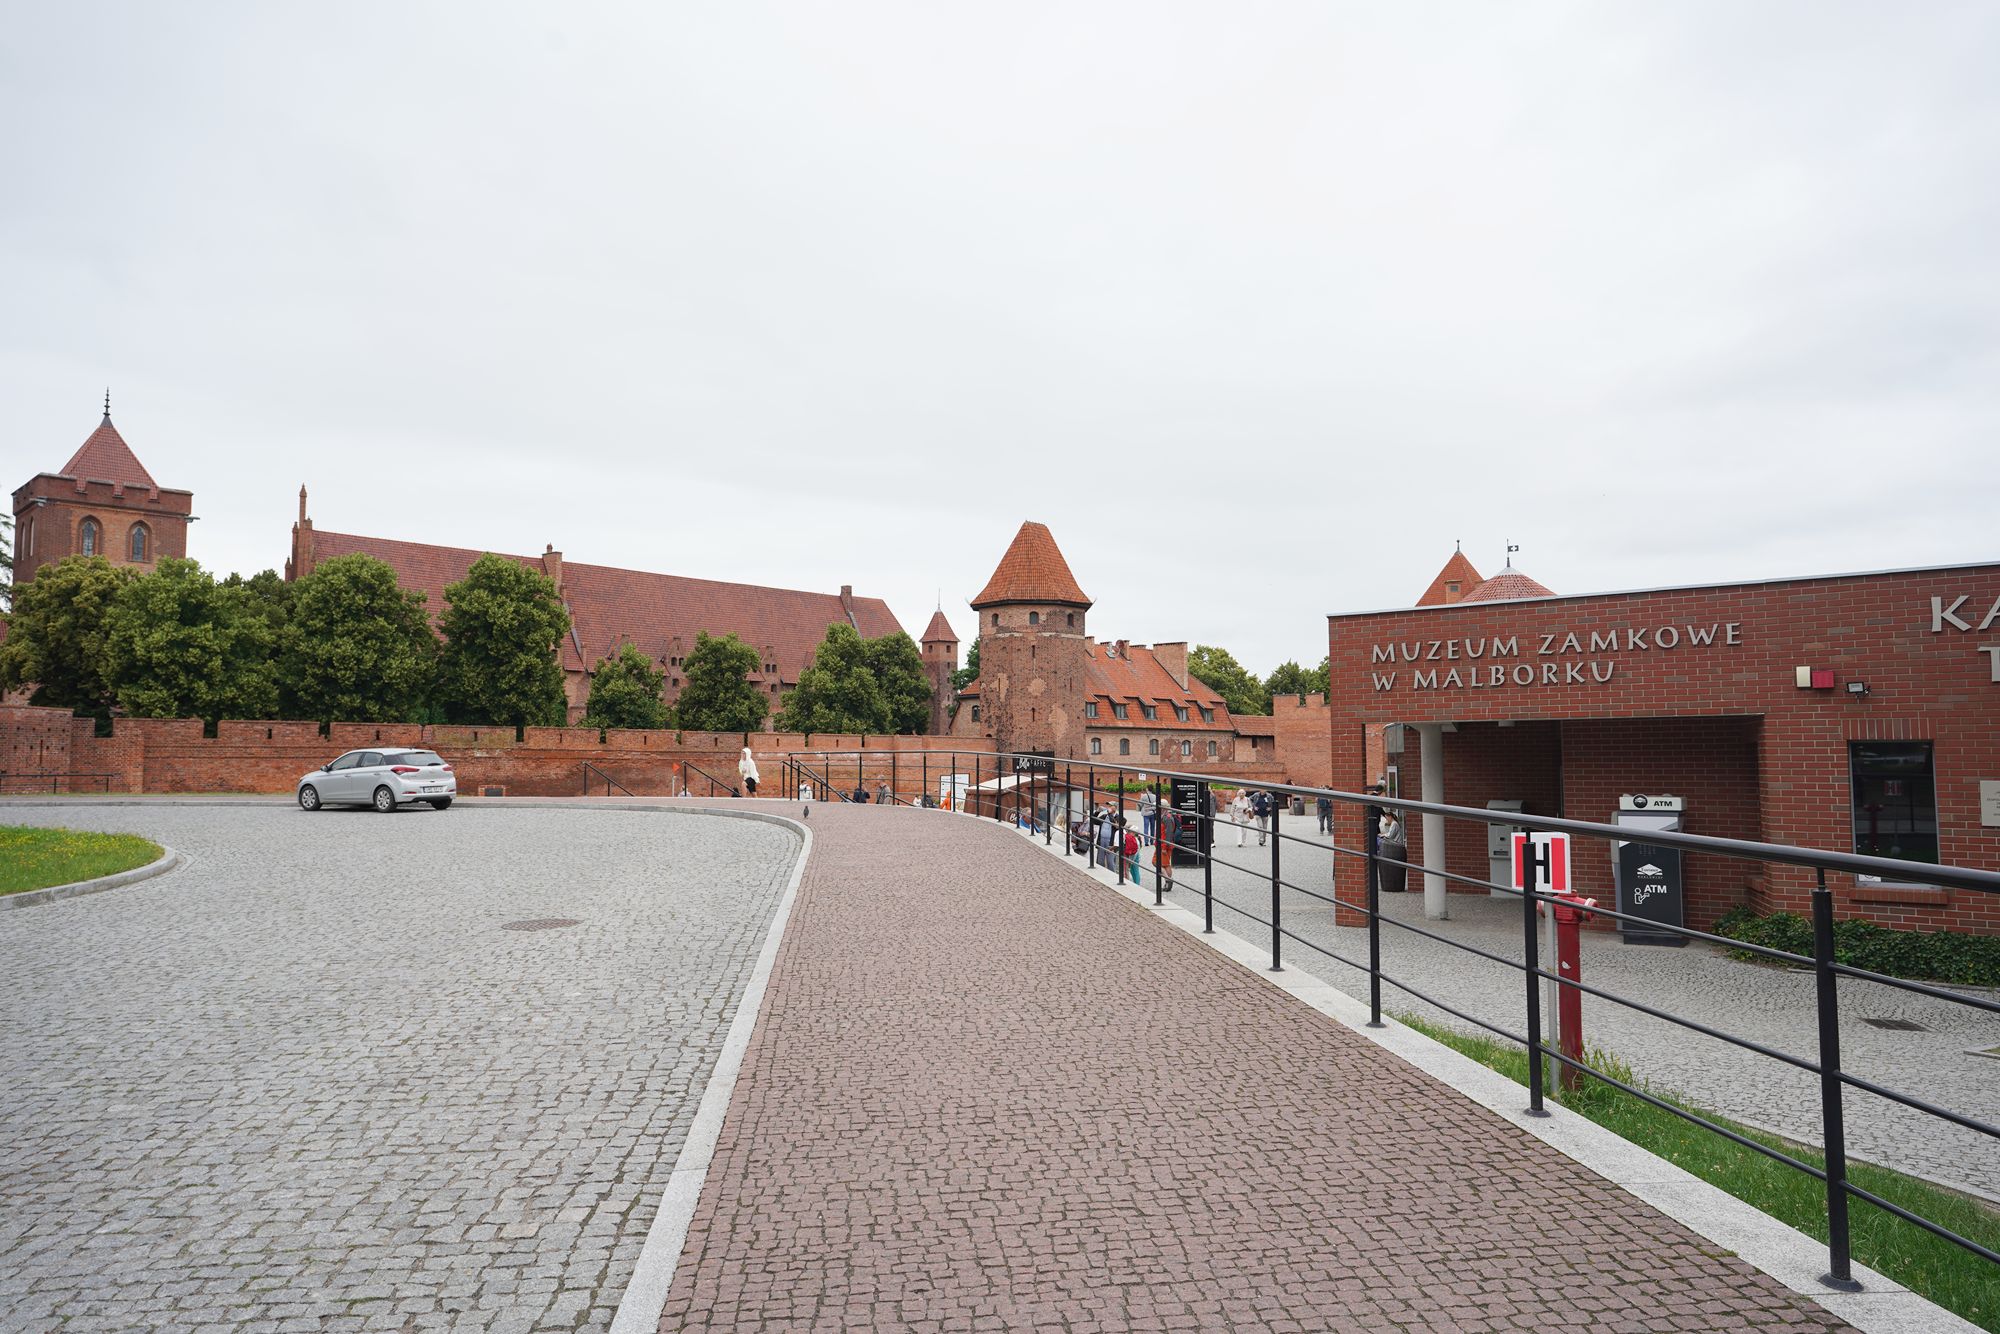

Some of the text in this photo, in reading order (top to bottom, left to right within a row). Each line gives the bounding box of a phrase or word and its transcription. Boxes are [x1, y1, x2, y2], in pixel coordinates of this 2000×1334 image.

[1372, 623, 1742, 664] MUZEUM ZAMKOWE
[1372, 661, 1614, 691] W MALBORKU
[1644, 884, 1667, 894] ATM
